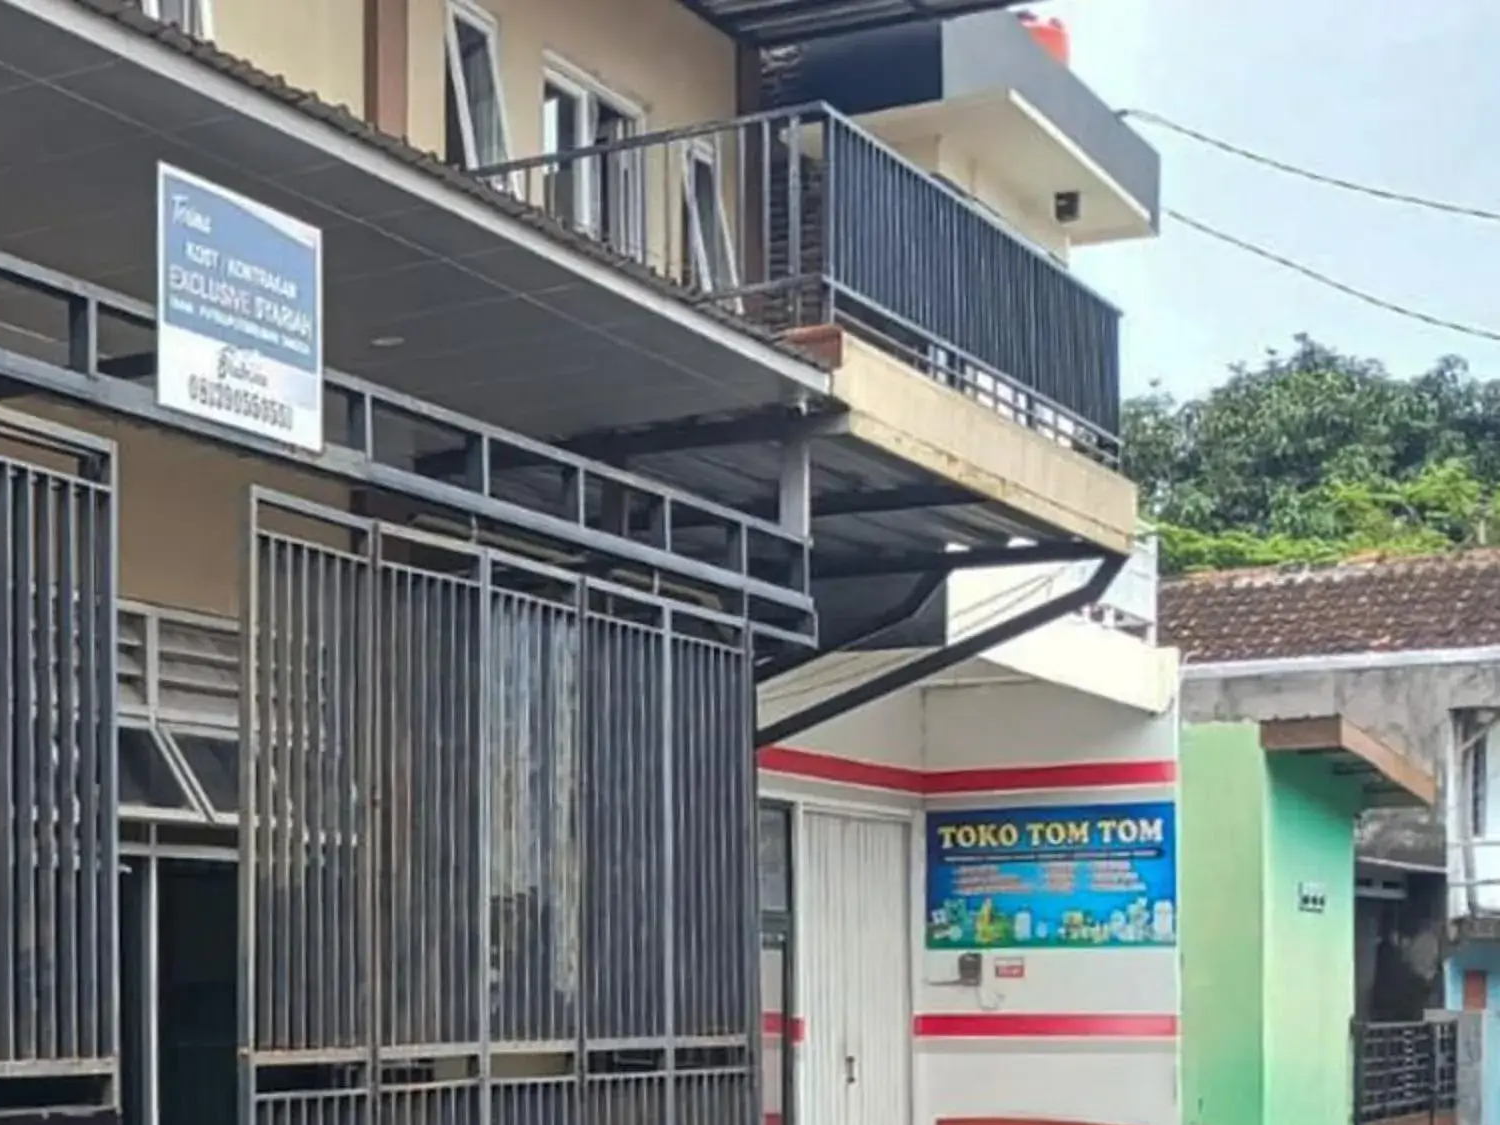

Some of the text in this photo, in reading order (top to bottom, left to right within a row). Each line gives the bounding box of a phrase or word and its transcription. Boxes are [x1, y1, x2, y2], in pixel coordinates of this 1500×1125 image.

[185, 240, 219, 269] KOST
[169, 263, 251, 317] EXCLUSIVE
[937, 818, 1163, 849] TOKO TOM TOM
